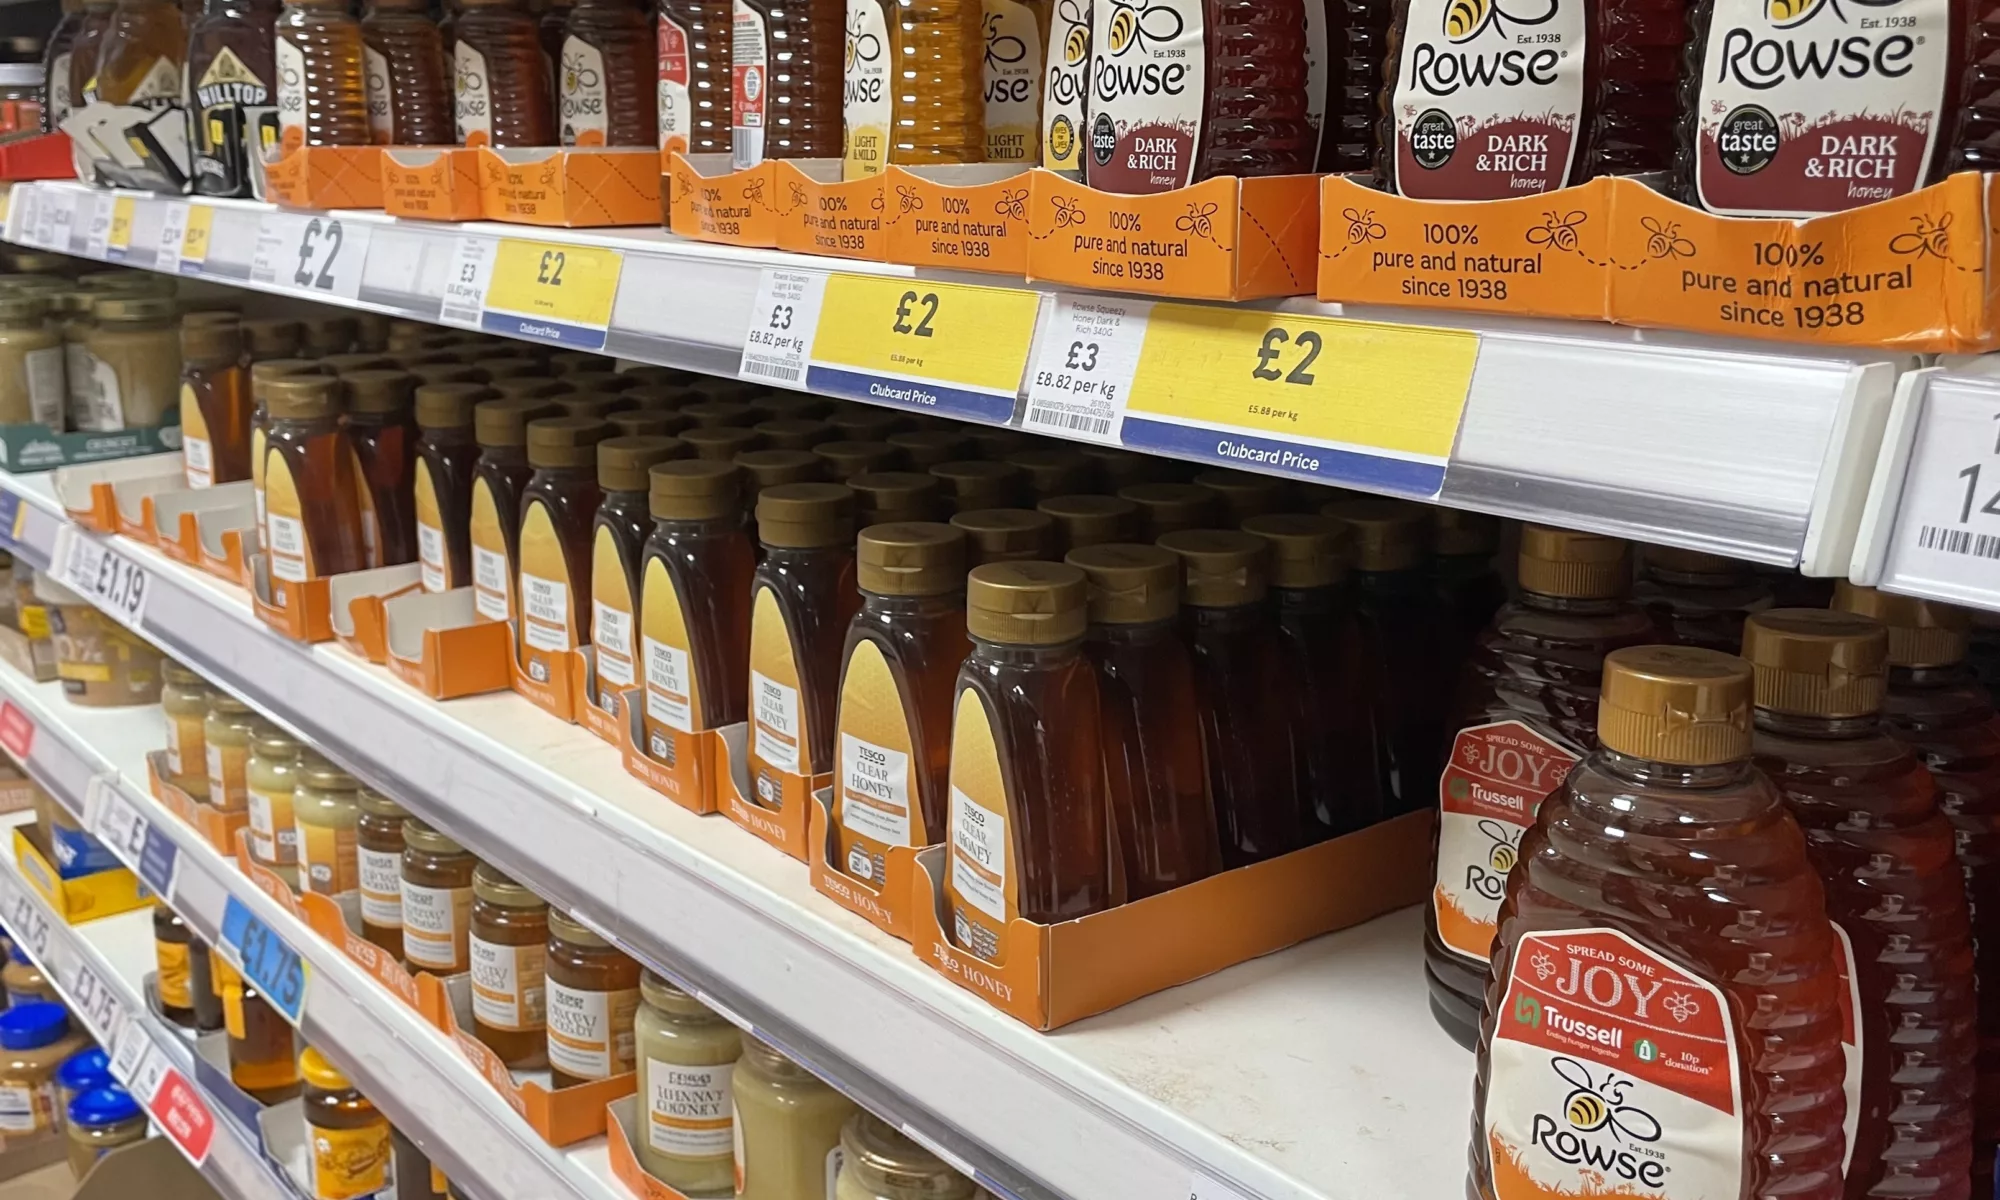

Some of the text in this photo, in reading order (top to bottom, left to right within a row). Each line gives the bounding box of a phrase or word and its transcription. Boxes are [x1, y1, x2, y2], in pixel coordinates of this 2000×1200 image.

[1409, 43, 1559, 96] Rowse
[1718, 27, 1913, 90] Rowse
[1093, 55, 1184, 102] Rowse
[1422, 120, 1444, 133] great
[1733, 119, 1763, 133] great
[854, 136, 877, 148] LIGHT
[988, 134, 1024, 146] LIGHT
[1094, 134, 1114, 148] taste
[1135, 138, 1177, 154] DARK
[1413, 131, 1455, 150] taste
[1488, 135, 1548, 153] DARK
[1721, 131, 1776, 152] taste
[1821, 135, 1897, 156] DARK
[1150, 171, 1176, 188] honey
[1510, 174, 1546, 192] honey
[1848, 181, 1893, 200] honey
[716, 204, 752, 218] natural
[941, 196, 970, 215] 100%
[716, 222, 740, 235] 1938
[840, 216, 880, 231] natural
[916, 220, 1006, 237] pure and natural
[1109, 211, 1141, 232] 100%
[838, 234, 864, 250] 1938
[1424, 223, 1478, 245] 100%
[294, 217, 343, 290] £2
[932, 238, 990, 258] since 1938
[1074, 235, 1188, 257] pure and natural
[1754, 242, 1824, 268] 100%
[537, 250, 565, 286] £2
[1092, 258, 1164, 280] since 1938
[1373, 250, 1542, 274] pure and natural
[1402, 276, 1507, 300] since 1938
[1682, 264, 1912, 298] pure and natural
[770, 304, 793, 330] £3
[892, 290, 940, 338] £2
[1072, 302, 1127, 317] Rowse Squeezy
[1072, 313, 1095, 325] Honey
[1096, 316, 1113, 326] Dark
[1720, 301, 1865, 328] since 1938
[1076, 324, 1113, 337] Rich 340G
[749, 330, 804, 354] £8.82 per kg
[1066, 341, 1099, 372] £3
[1252, 327, 1322, 386] £2
[870, 383, 936, 406] Clubcard Price
[1036, 371, 1116, 400] £8.82 per kg
[1248, 404, 1298, 422] £5.88 per kg
[1216, 440, 1320, 472] Clubcard Price
[96, 552, 146, 613] £1.19
[653, 658, 675, 676] CLEAR
[652, 669, 678, 691] HONEY
[762, 695, 784, 715] CLEAR
[760, 706, 788, 731] HONEY
[858, 746, 886, 762] TESCO
[1486, 734, 1545, 756] SPREAD SOME
[856, 761, 888, 782] CLEAR
[1479, 744, 1551, 787] JOY
[852, 773, 893, 800] HONEY
[1471, 782, 1524, 812] Trussell
[964, 802, 984, 823] TESCO
[750, 814, 787, 842] HONEY
[962, 818, 986, 846] CLEAR
[959, 830, 992, 865] HONEY
[852, 890, 893, 924] HONEY
[240, 917, 301, 1007] £1.75
[1566, 944, 1656, 978] SPREAD SOME
[962, 964, 1013, 1002] HONEY
[1556, 957, 1662, 1018] JOY
[1544, 1006, 1622, 1050] Trussell
[1546, 1029, 1620, 1060] Ending hunger together
[1681, 1052, 1700, 1064] 10p
[1532, 1113, 1664, 1188] Rowse
